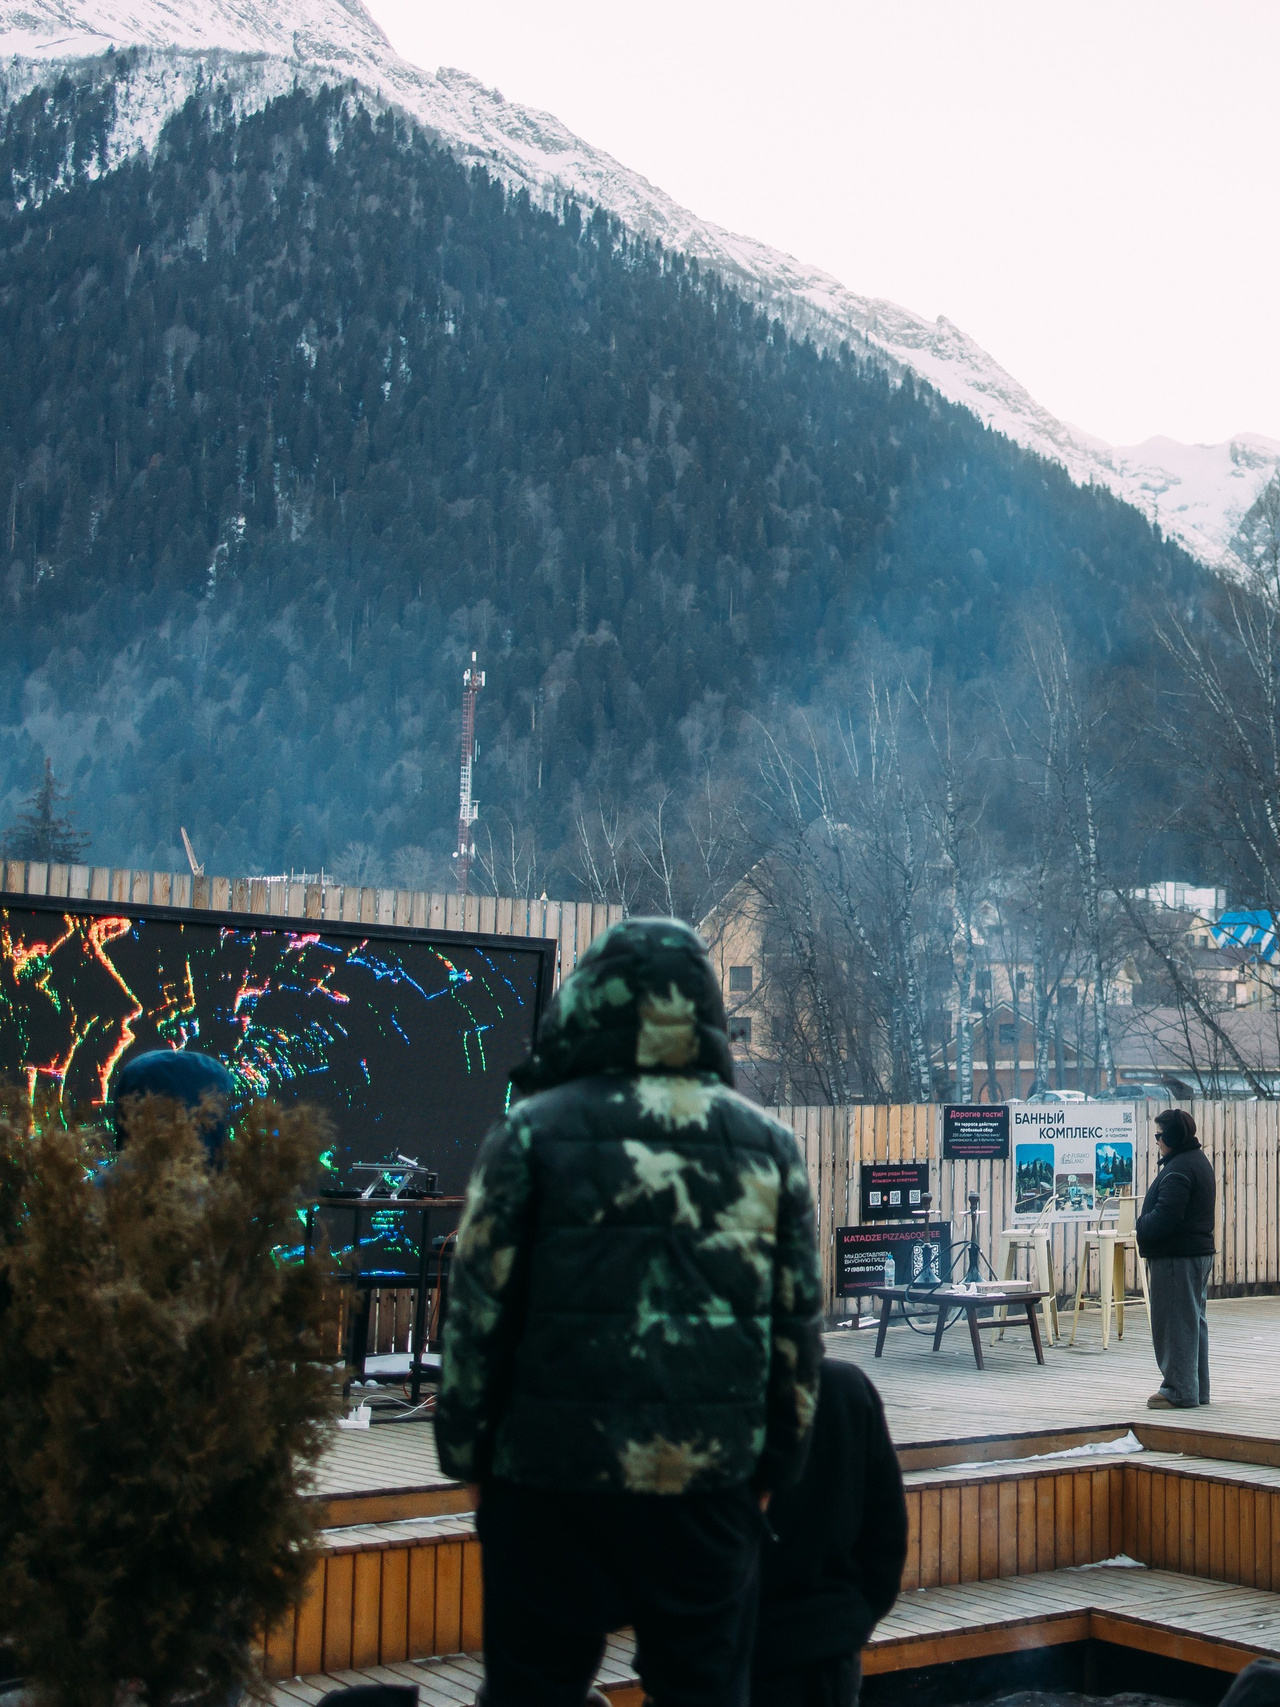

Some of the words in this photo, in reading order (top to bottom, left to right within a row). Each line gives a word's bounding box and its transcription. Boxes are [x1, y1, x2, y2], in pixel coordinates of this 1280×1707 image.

[950, 1110, 981, 1119] Дорогие
[1015, 1110, 1064, 1124] БАННЫЙ
[1040, 1127, 1103, 1139] КОМПЛЕКС
[844, 1234, 881, 1242] KATADZE
